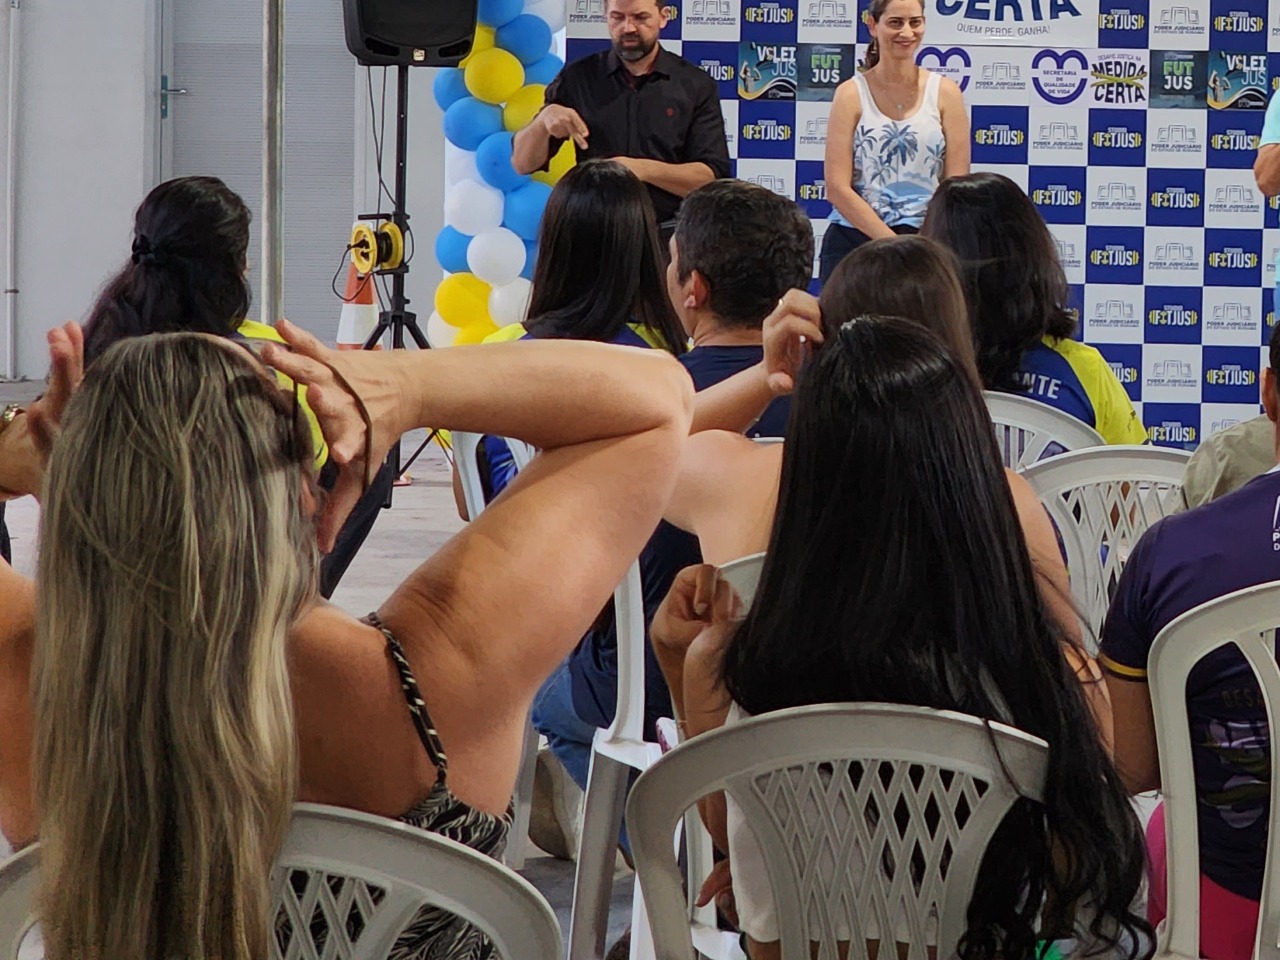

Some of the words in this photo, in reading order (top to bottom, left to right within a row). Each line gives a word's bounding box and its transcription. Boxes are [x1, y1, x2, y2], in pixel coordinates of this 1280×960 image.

[957, 23, 982, 34] QUEM
[772, 61, 796, 76] JUS
[811, 54, 842, 69] FUT
[1163, 61, 1195, 76] FUT
[811, 69, 840, 83] JUS
[1091, 61, 1145, 80] MEDIDA
[1241, 70, 1266, 86] JUS
[1164, 75, 1193, 90] JUS
[1094, 82, 1146, 104] CERTA
